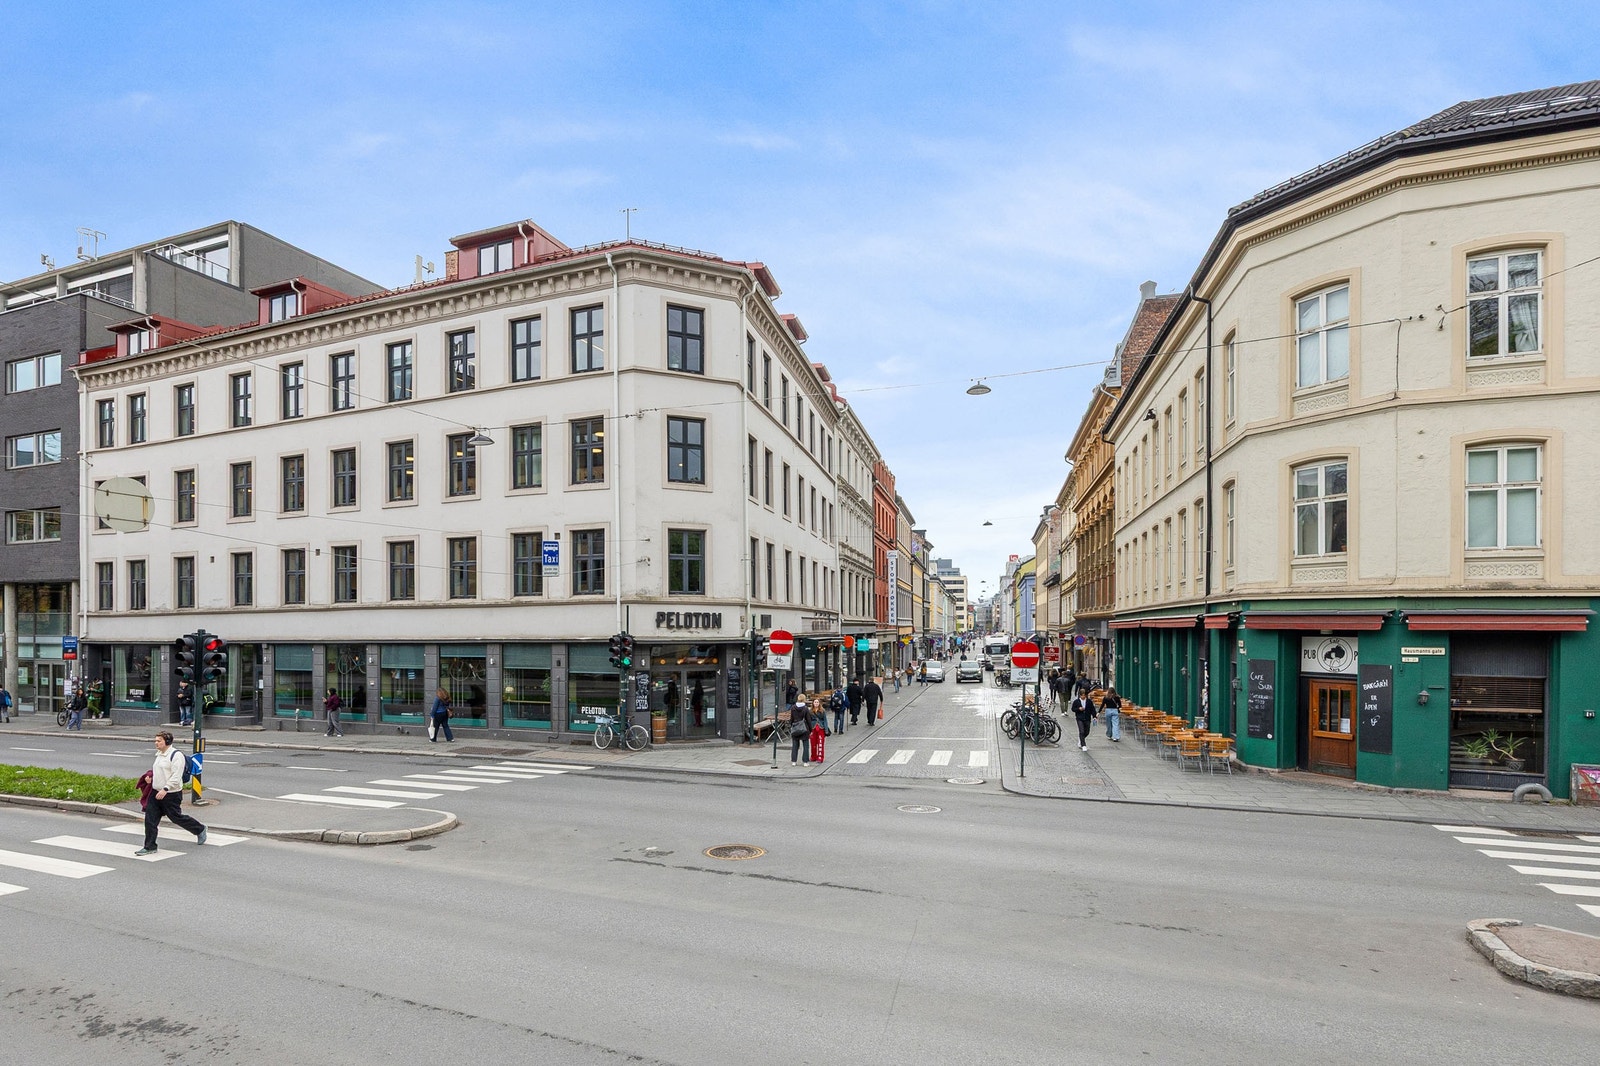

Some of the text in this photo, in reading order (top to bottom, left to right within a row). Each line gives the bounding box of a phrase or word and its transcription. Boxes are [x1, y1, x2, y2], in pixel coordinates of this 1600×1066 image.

[543, 554, 559, 563] Taxi
[655, 611, 722, 629] PELOTON
[1303, 649, 1317, 660] PUB
[581, 706, 606, 715] PELOTON
